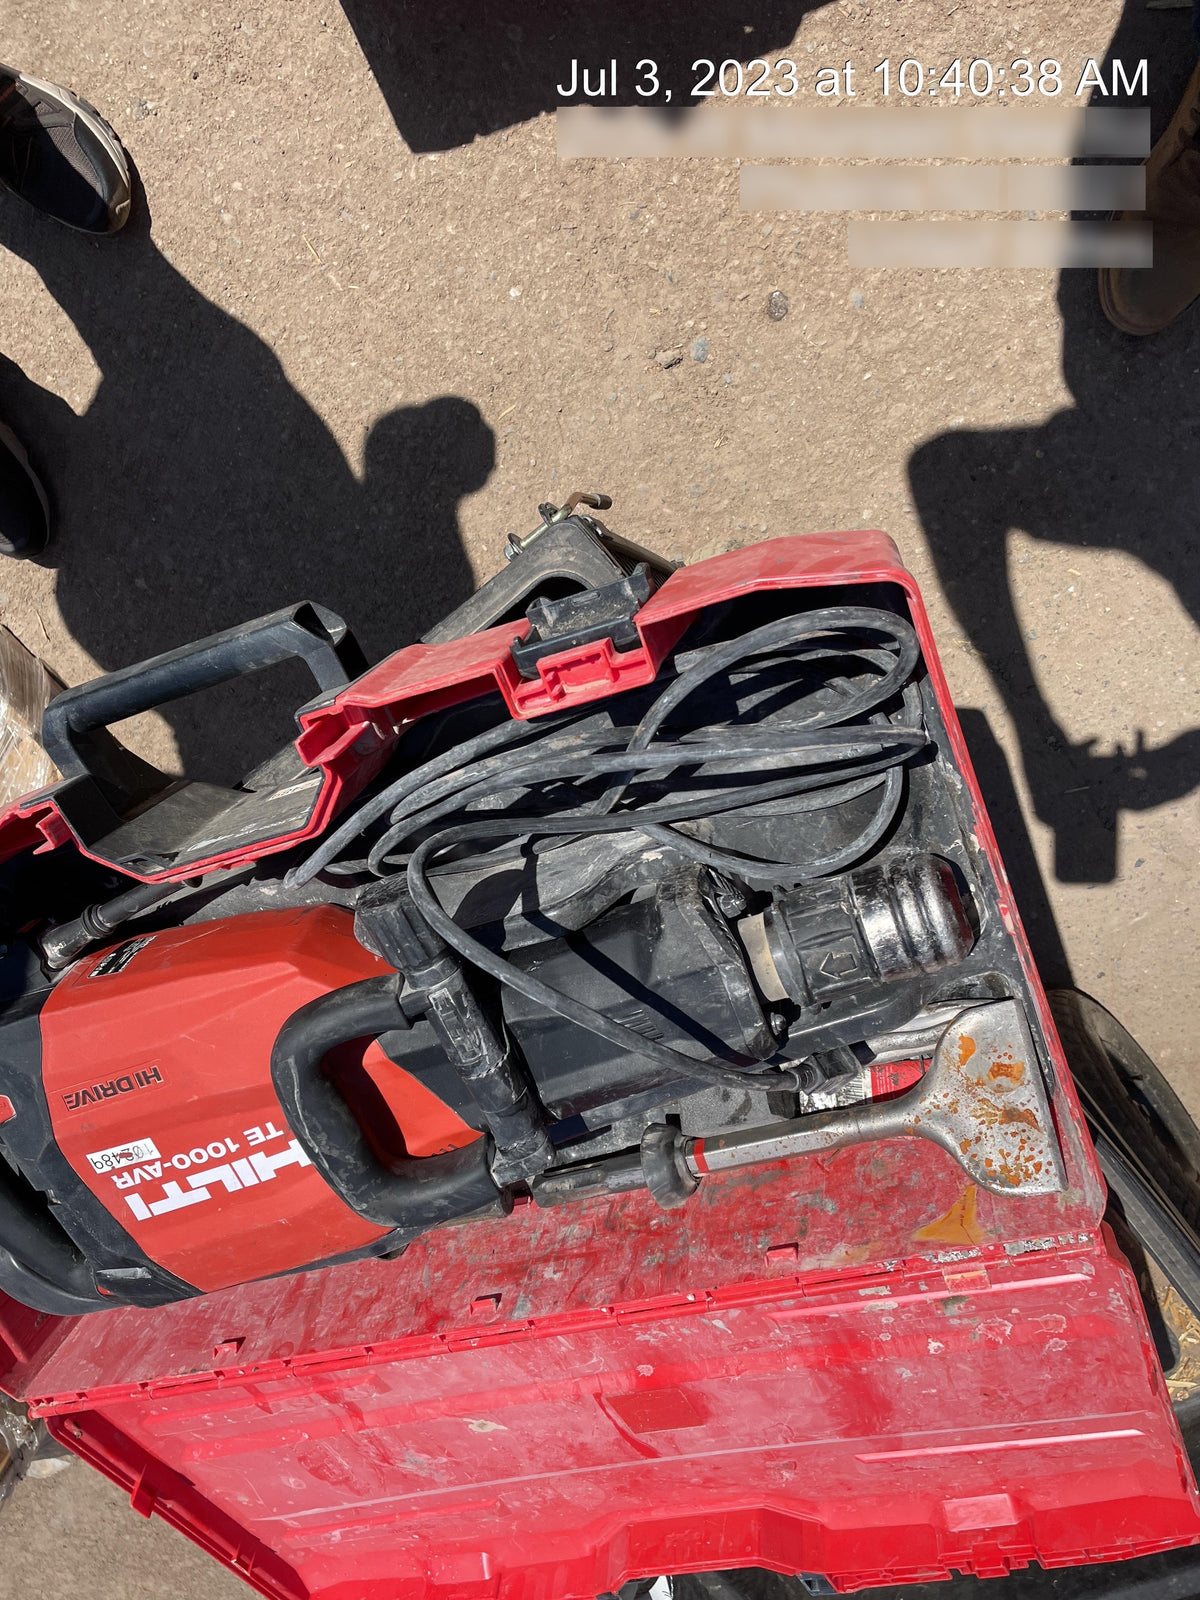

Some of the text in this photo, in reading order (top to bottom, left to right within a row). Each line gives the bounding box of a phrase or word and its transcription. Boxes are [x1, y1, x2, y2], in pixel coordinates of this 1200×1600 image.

[63, 1066, 164, 1112] HI DRIVE
[111, 1121, 284, 1190] TE 1000-AVR
[124, 1138, 312, 1221] HILTI
